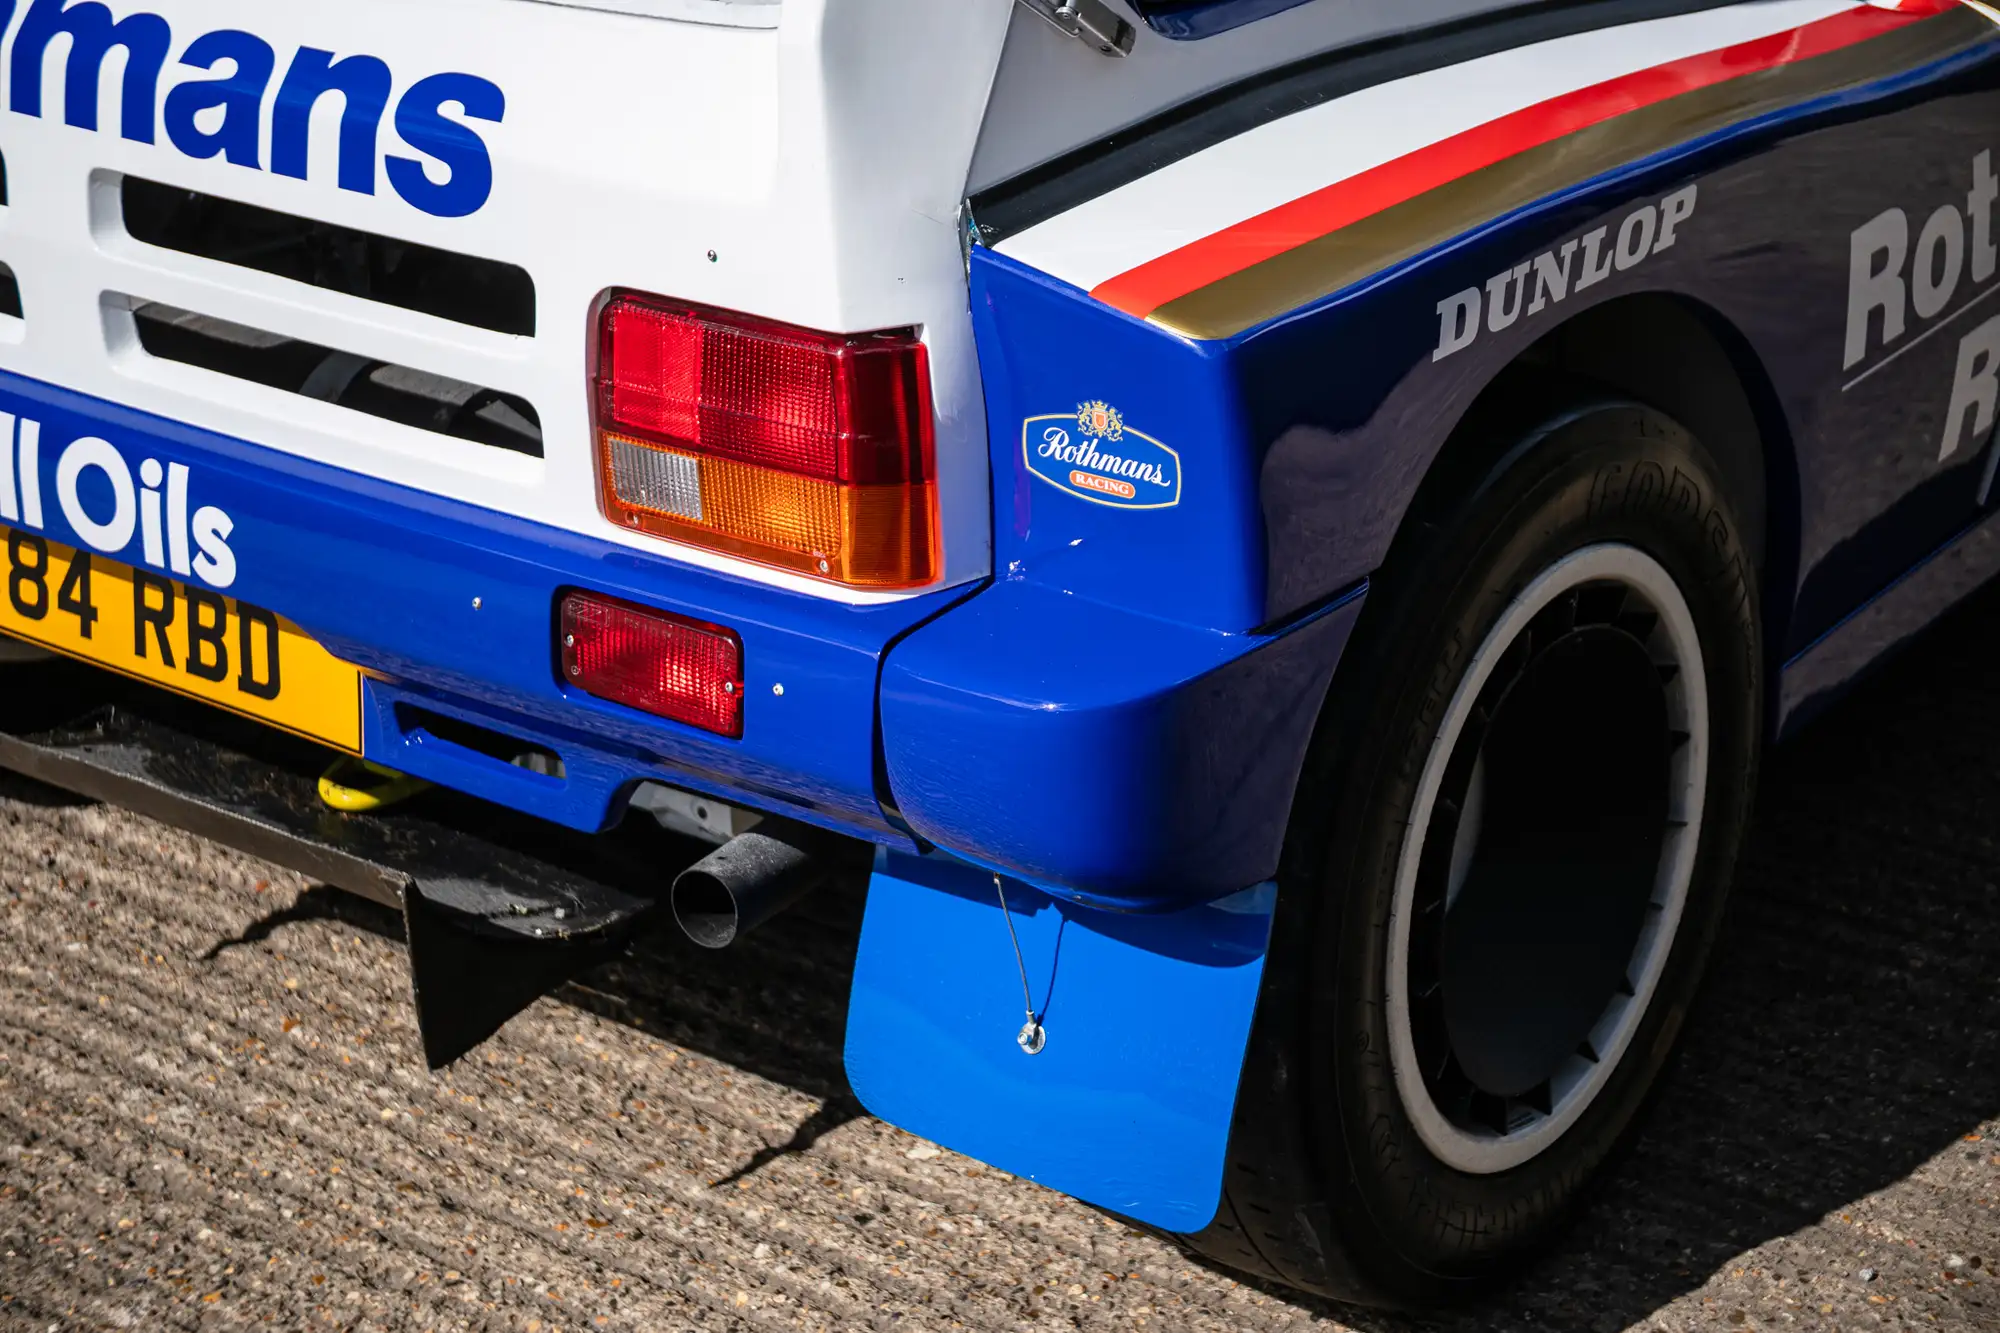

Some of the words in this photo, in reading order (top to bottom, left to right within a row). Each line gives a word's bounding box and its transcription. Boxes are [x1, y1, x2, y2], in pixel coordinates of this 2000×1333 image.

[0, 0, 505, 218] mans
[1432, 184, 1698, 363] DUNLOP
[56, 436, 237, 588] Oils
[1038, 427, 1171, 487] Rothmans
[1075, 473, 1129, 495] RACING
[8, 528, 98, 640] 84
[132, 566, 281, 701] RBD
